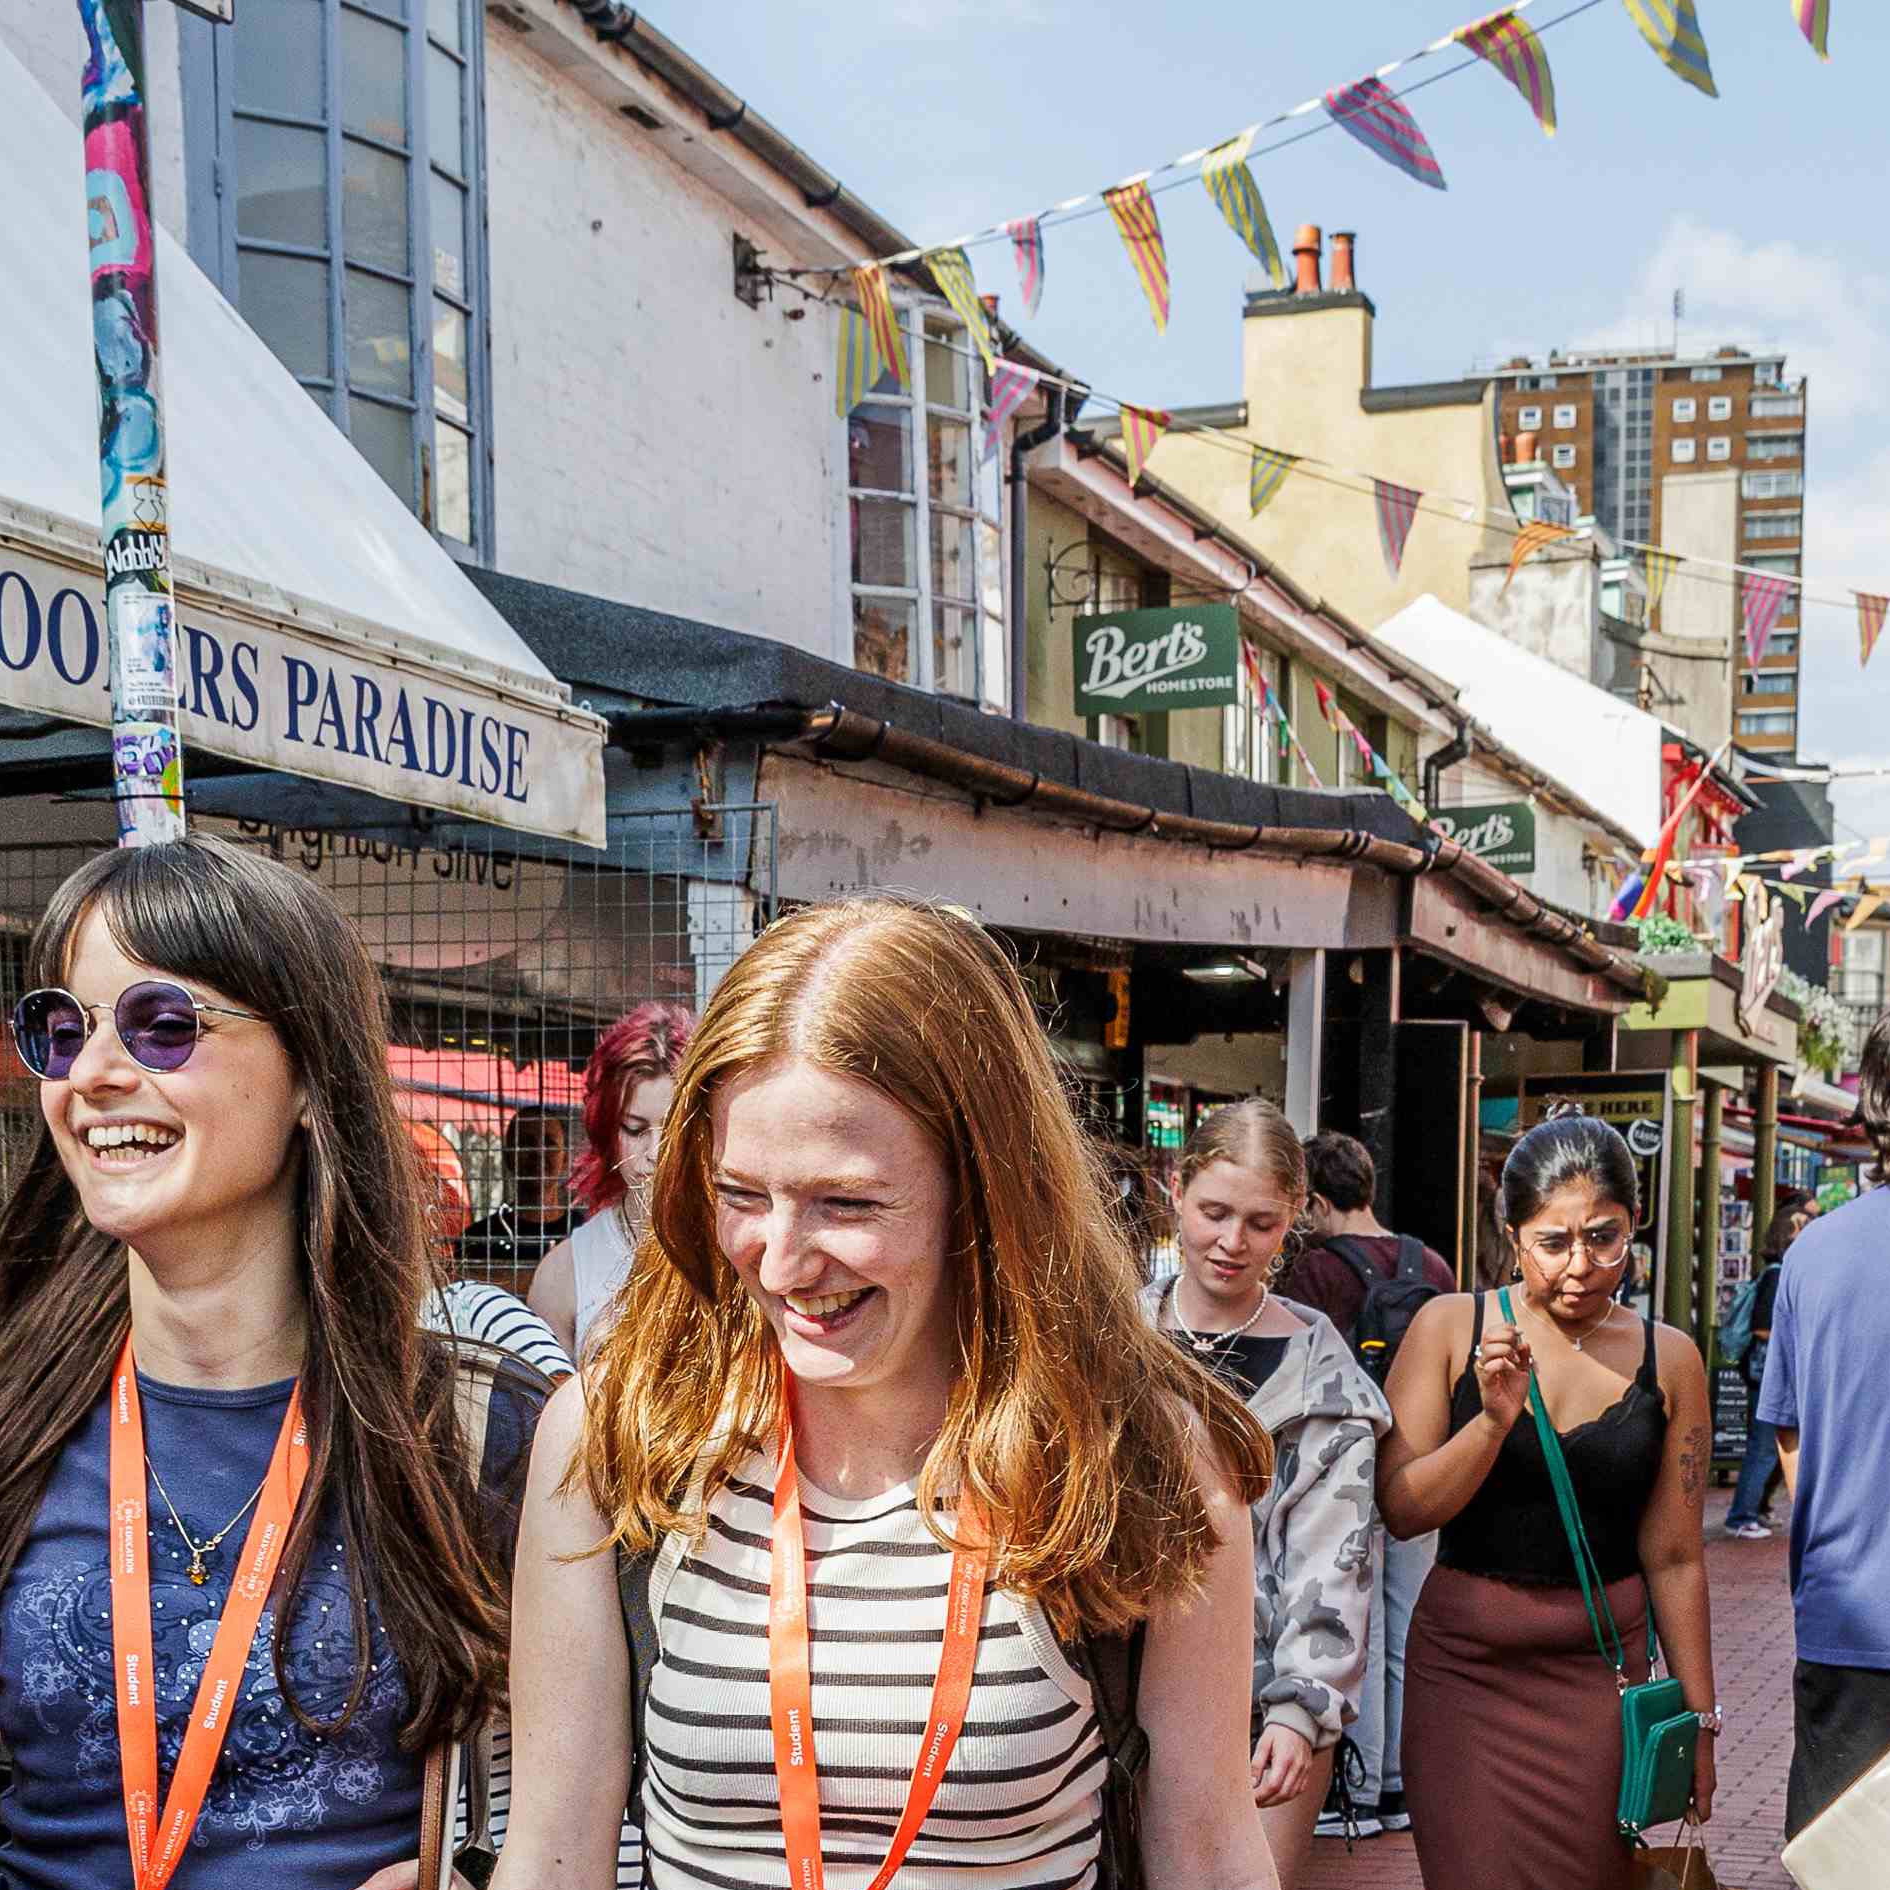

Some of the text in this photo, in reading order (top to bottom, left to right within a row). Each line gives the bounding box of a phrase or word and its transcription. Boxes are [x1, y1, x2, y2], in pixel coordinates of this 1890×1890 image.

[1080, 621, 1208, 697] Bert's
[1146, 674, 1233, 693] HOMESTORE
[284, 653, 532, 804] PARADISE
[114, 1375, 132, 1423] Student
[124, 1526, 134, 1574] EDUCATION
[252, 1521, 275, 1572] EDUCATION
[953, 1581, 973, 1635] EDUCATION
[123, 1653, 143, 1706] Student
[202, 1677, 229, 1730] Student
[786, 1708, 803, 1766] Student
[921, 1721, 949, 1778] Student
[161, 1807, 185, 1861] EDUCATION
